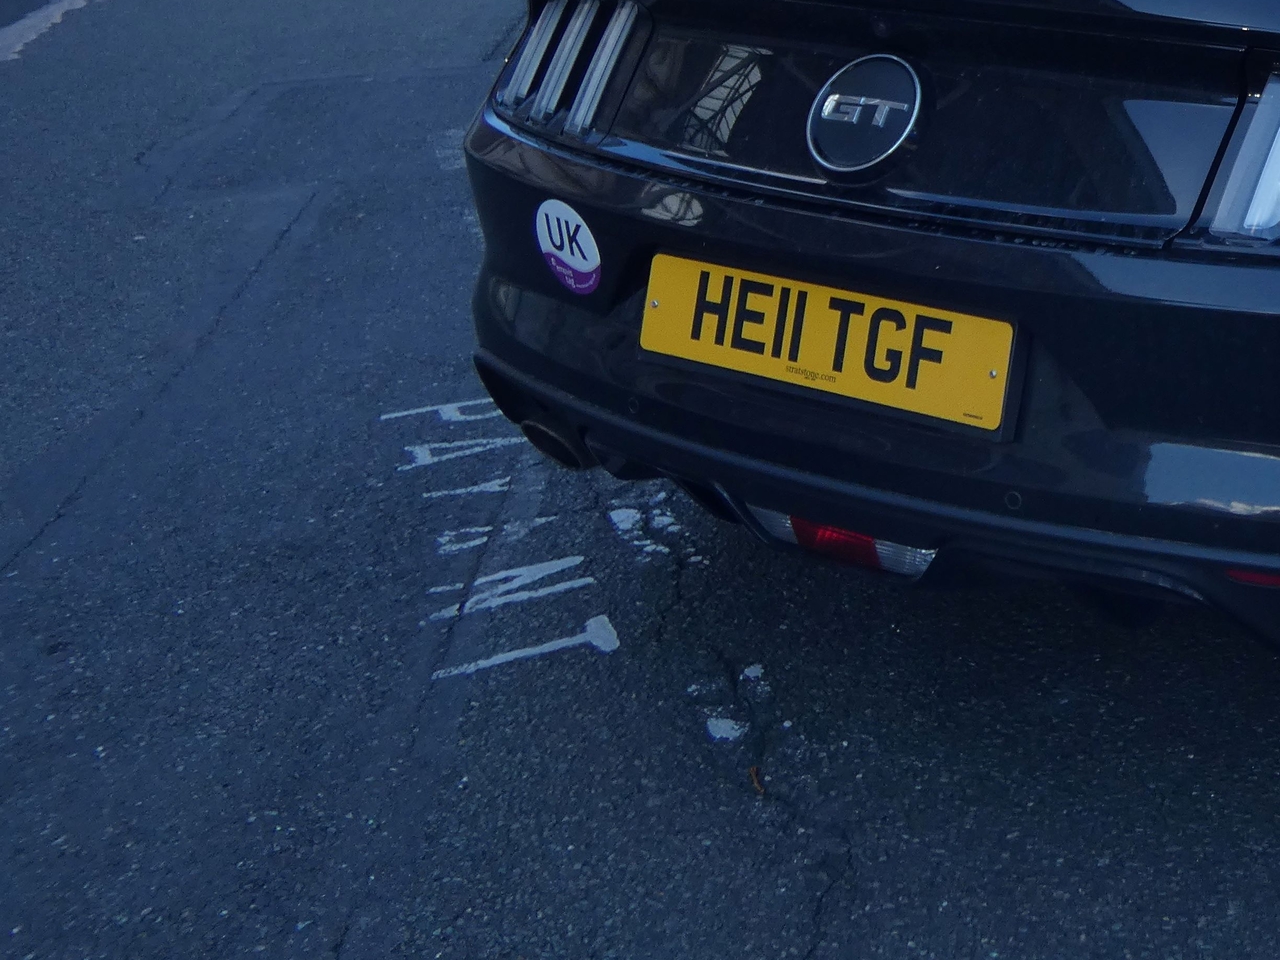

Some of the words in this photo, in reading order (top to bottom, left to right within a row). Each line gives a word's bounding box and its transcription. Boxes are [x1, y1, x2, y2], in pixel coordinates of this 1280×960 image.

[822, 93, 909, 128] GT
[544, 213, 588, 262] UK
[829, 297, 953, 390] TGF
